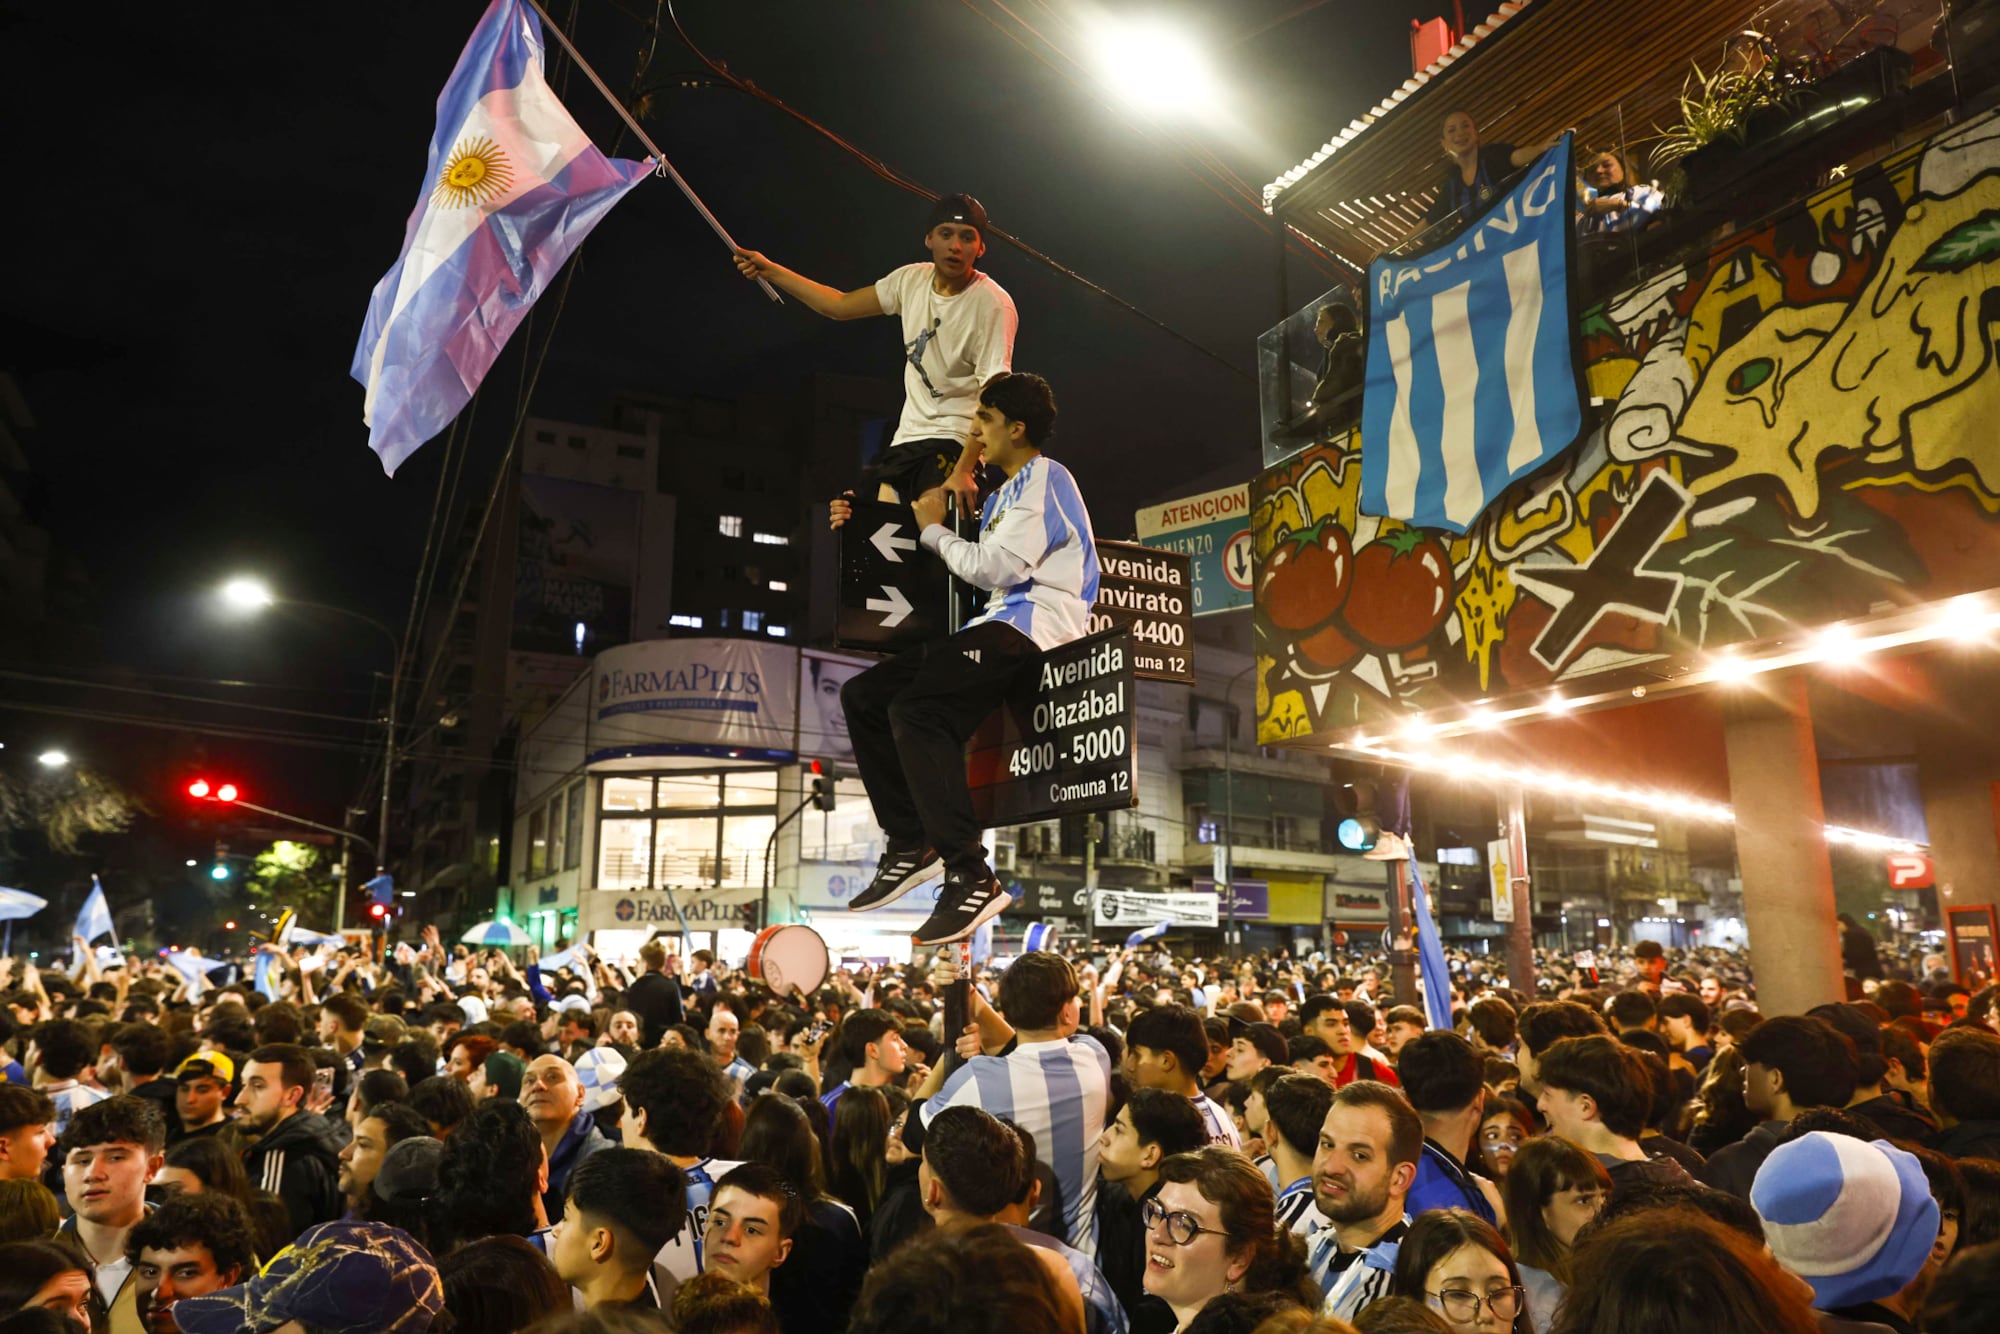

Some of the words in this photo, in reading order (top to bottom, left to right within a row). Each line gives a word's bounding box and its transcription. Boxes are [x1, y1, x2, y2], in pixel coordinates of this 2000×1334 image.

[1378, 163, 1557, 306] RANG
[1161, 491, 1246, 528] ATENCION
[1150, 533, 1213, 556] MIENZO
[1098, 556, 1182, 586] venida
[1098, 584, 1184, 615] nvirato
[1087, 613, 1114, 636] 00
[1132, 619, 1185, 647] 4400
[1039, 643, 1124, 692] Avenida
[1134, 656, 1164, 671] una
[1168, 656, 1186, 673] 12
[1033, 681, 1125, 733] Olazábal
[1009, 742, 1055, 777] 4900
[1073, 725, 1126, 765] 5000
[1050, 779, 1107, 803] Comuna
[1111, 770, 1129, 793] 12
